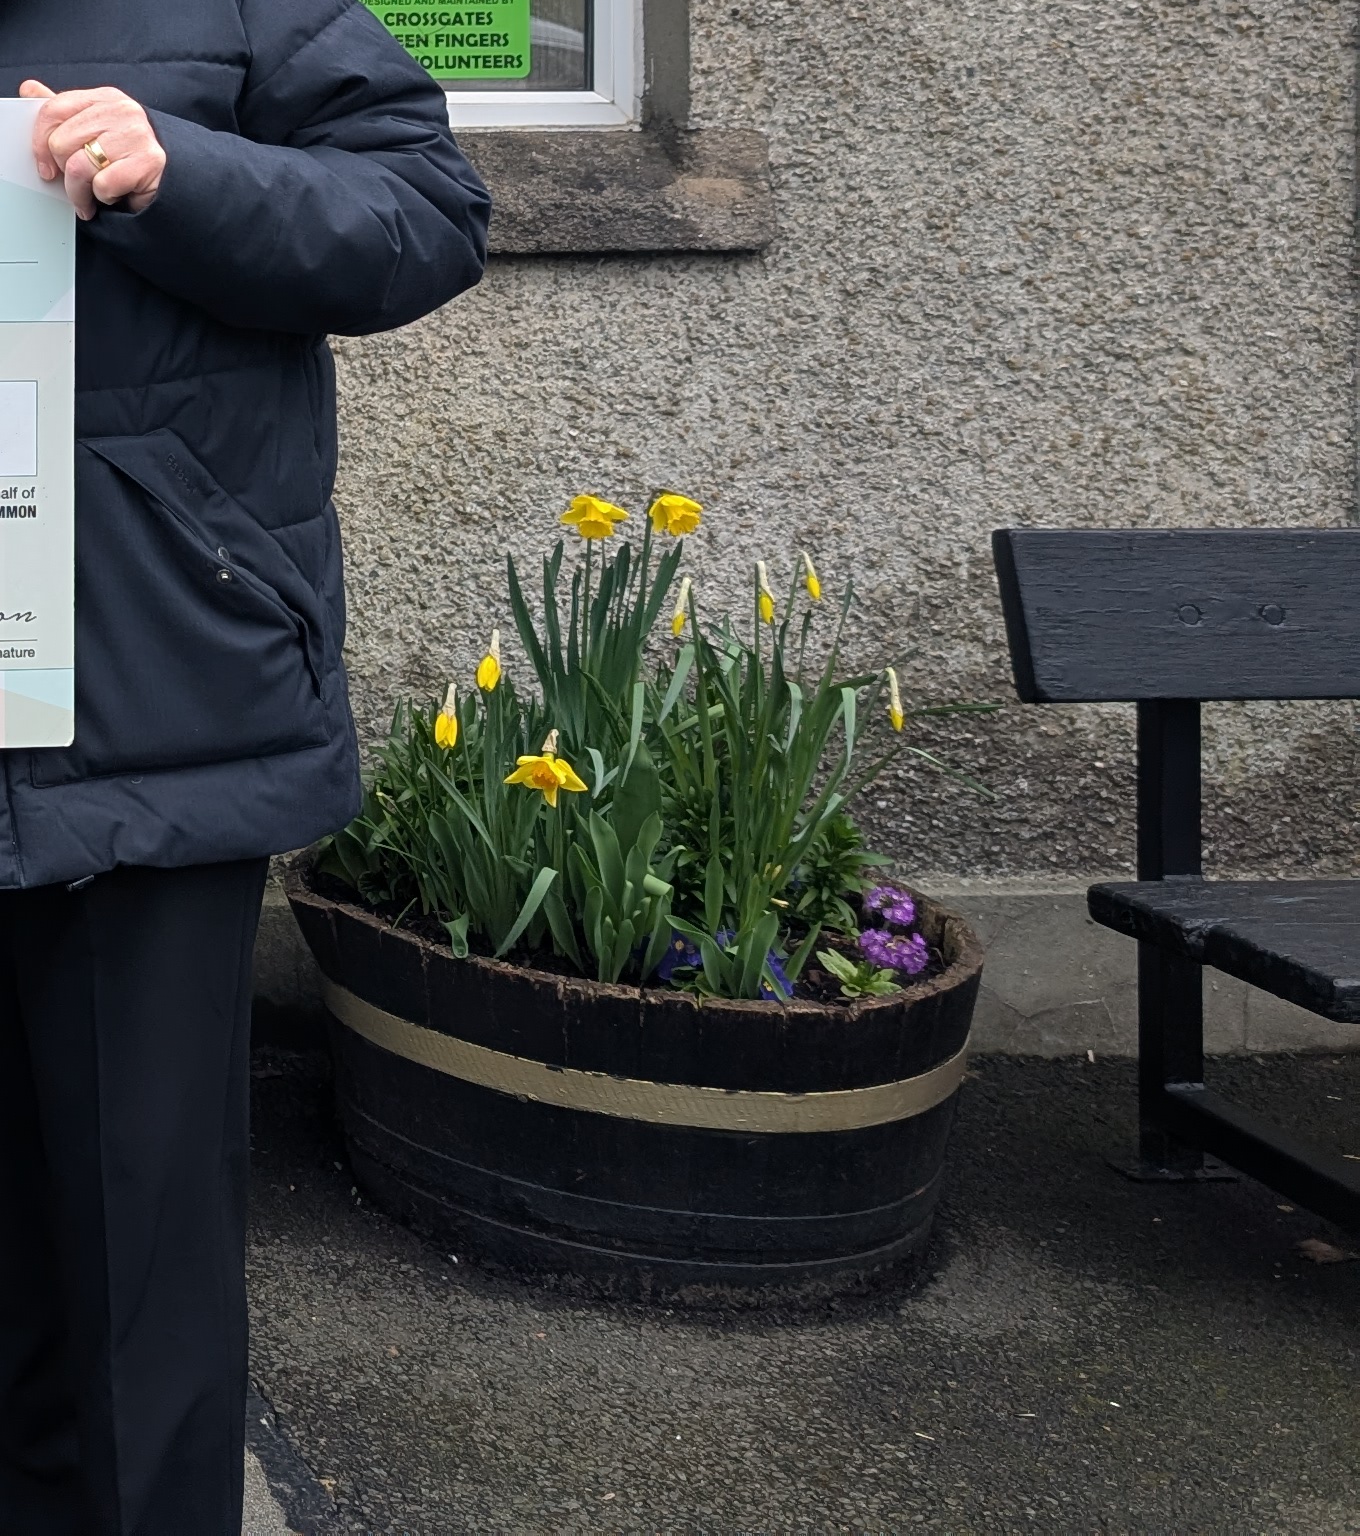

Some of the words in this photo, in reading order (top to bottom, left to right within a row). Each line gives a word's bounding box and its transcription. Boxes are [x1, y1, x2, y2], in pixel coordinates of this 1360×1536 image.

[383, 12, 494, 27] CROSSGATES
[393, 33, 430, 48] EEN
[434, 33, 510, 48] FINGERS
[21, 486, 36, 499] of
